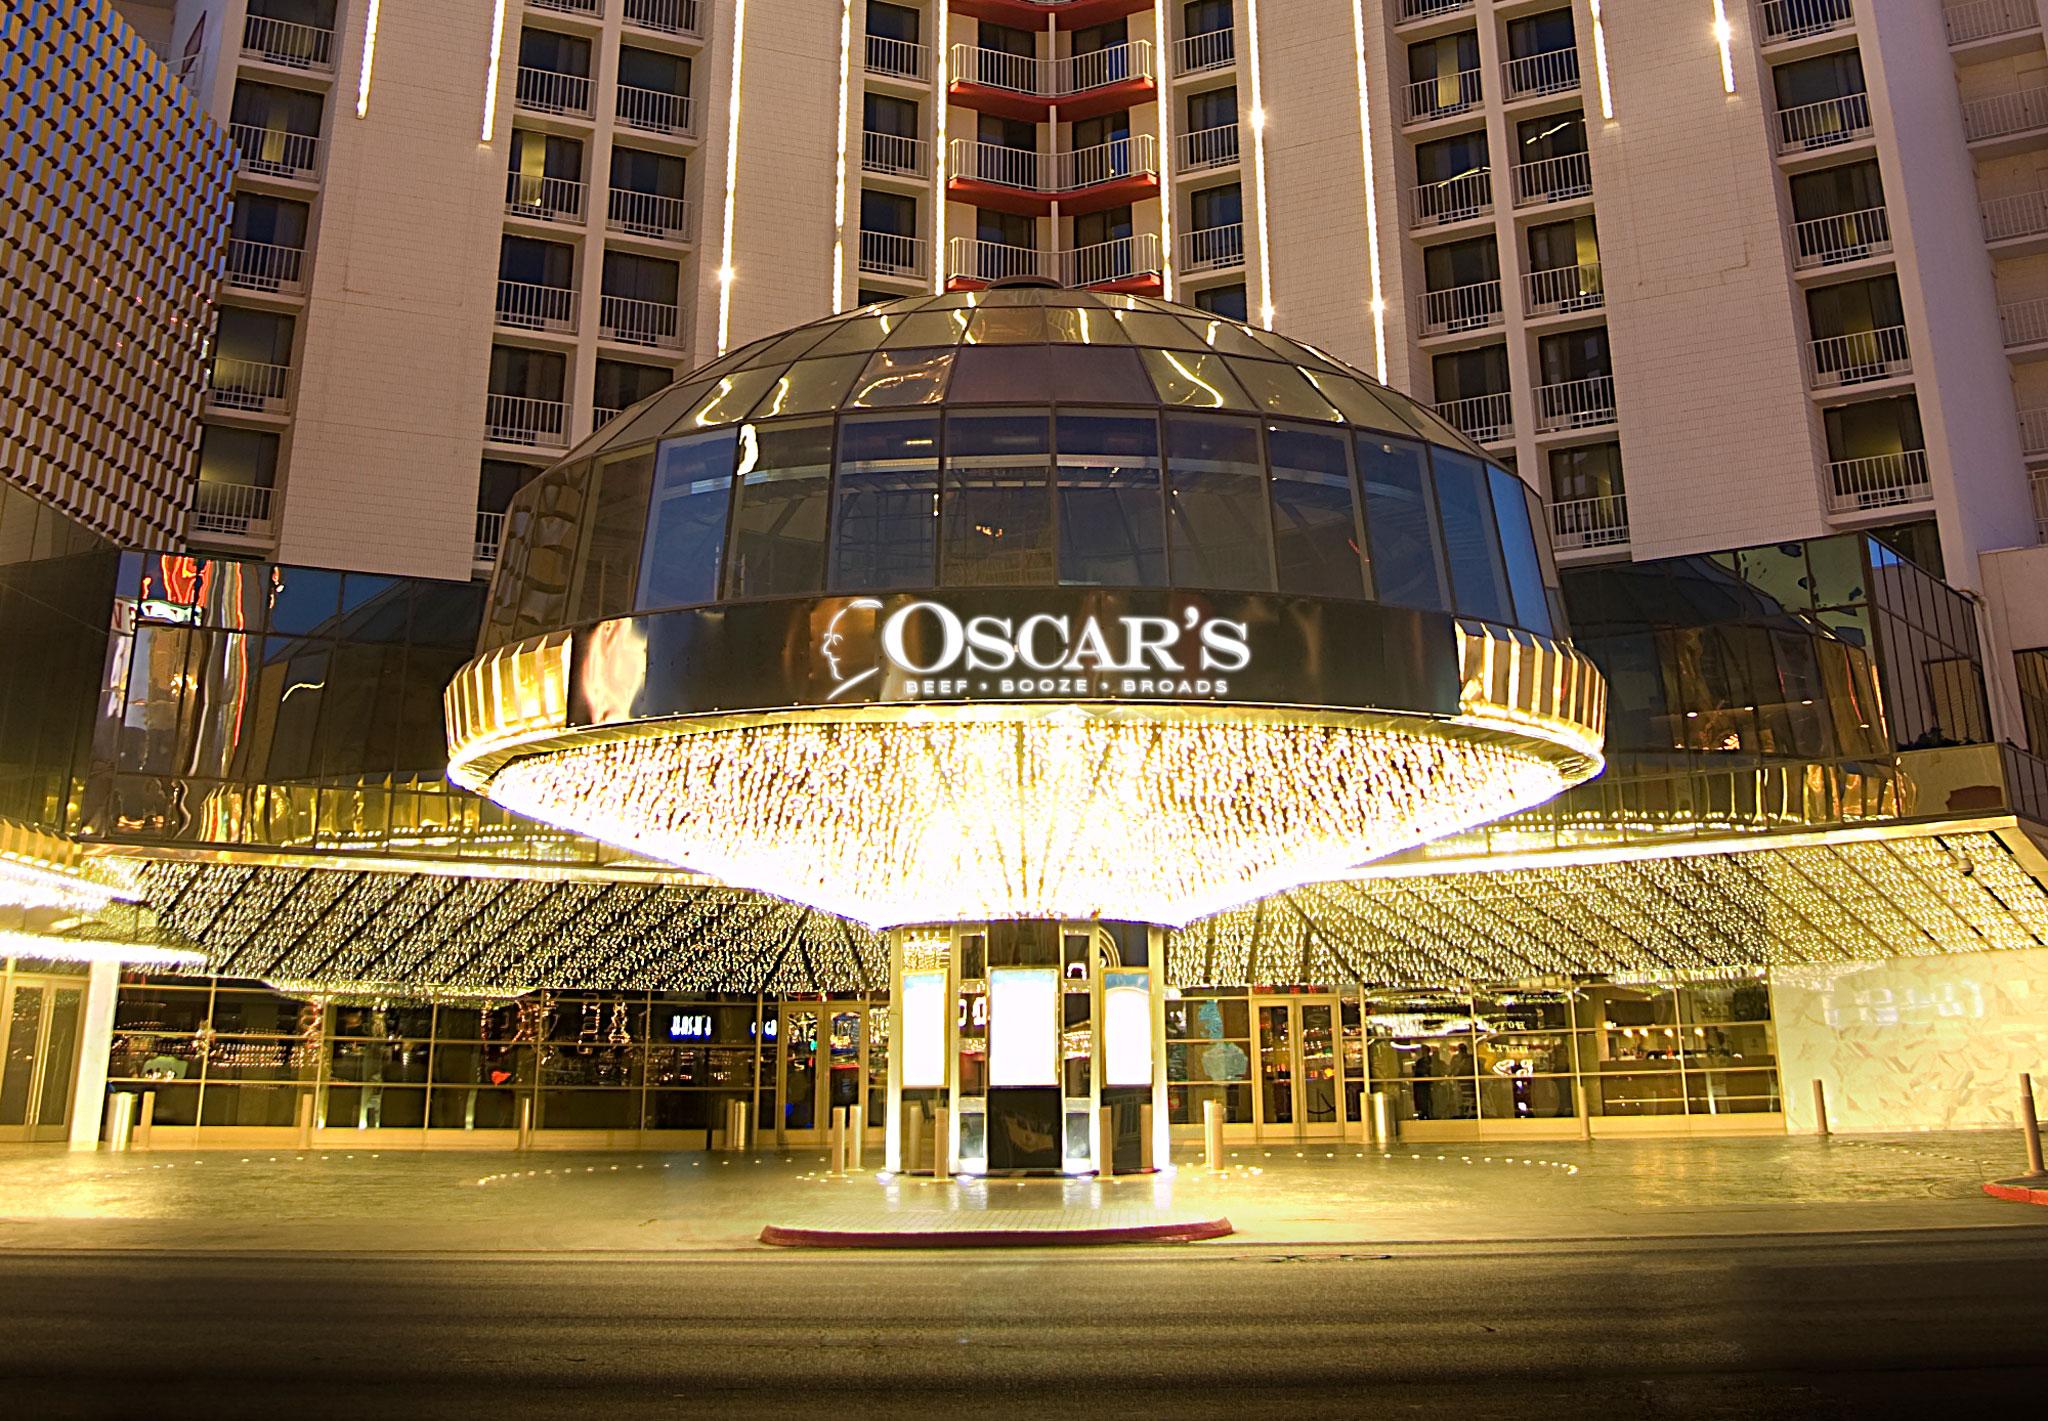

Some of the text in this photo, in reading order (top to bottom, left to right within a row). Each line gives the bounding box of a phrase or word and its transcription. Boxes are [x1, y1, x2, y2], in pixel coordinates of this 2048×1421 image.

[882, 602, 1251, 674] OSCAR'S
[905, 678, 1228, 694] BEEF BOOZE BROADS
